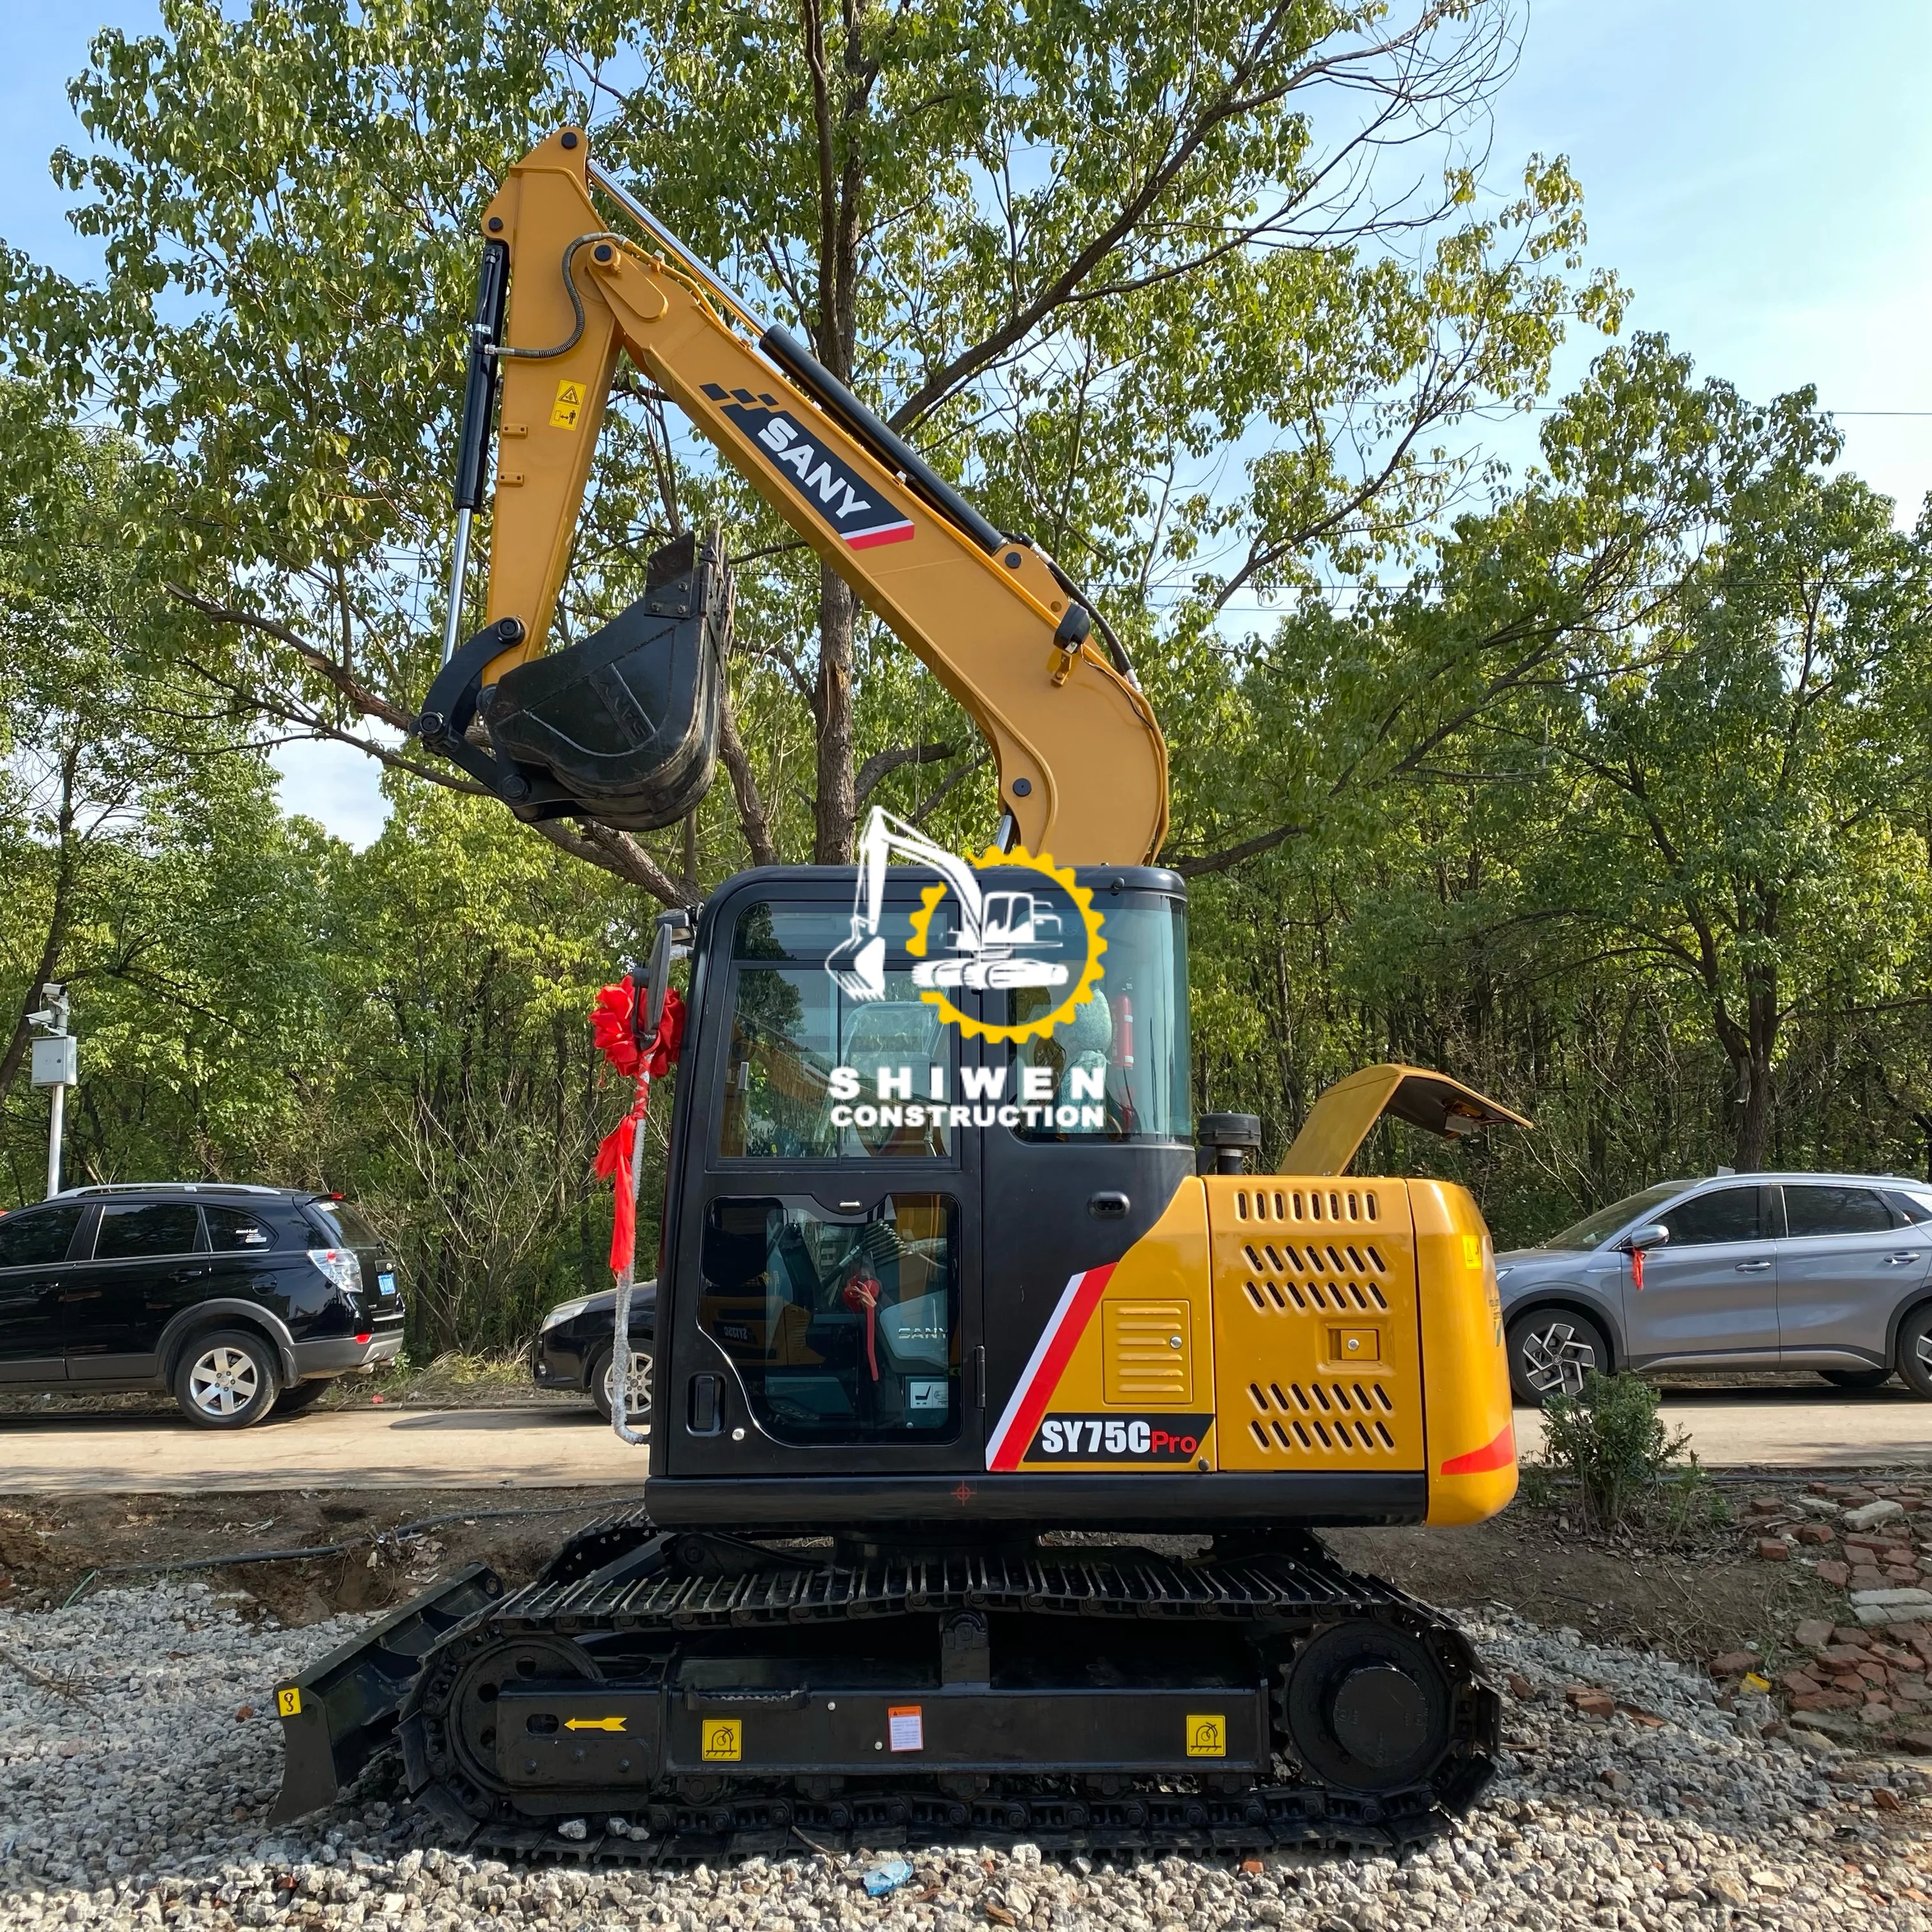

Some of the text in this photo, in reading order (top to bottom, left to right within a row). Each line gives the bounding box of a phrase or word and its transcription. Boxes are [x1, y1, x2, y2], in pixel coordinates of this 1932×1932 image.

[758, 417, 871, 519] SANY
[898, 1328, 947, 1339] SANY
[1041, 1421, 1197, 1453] SY75C Pro
